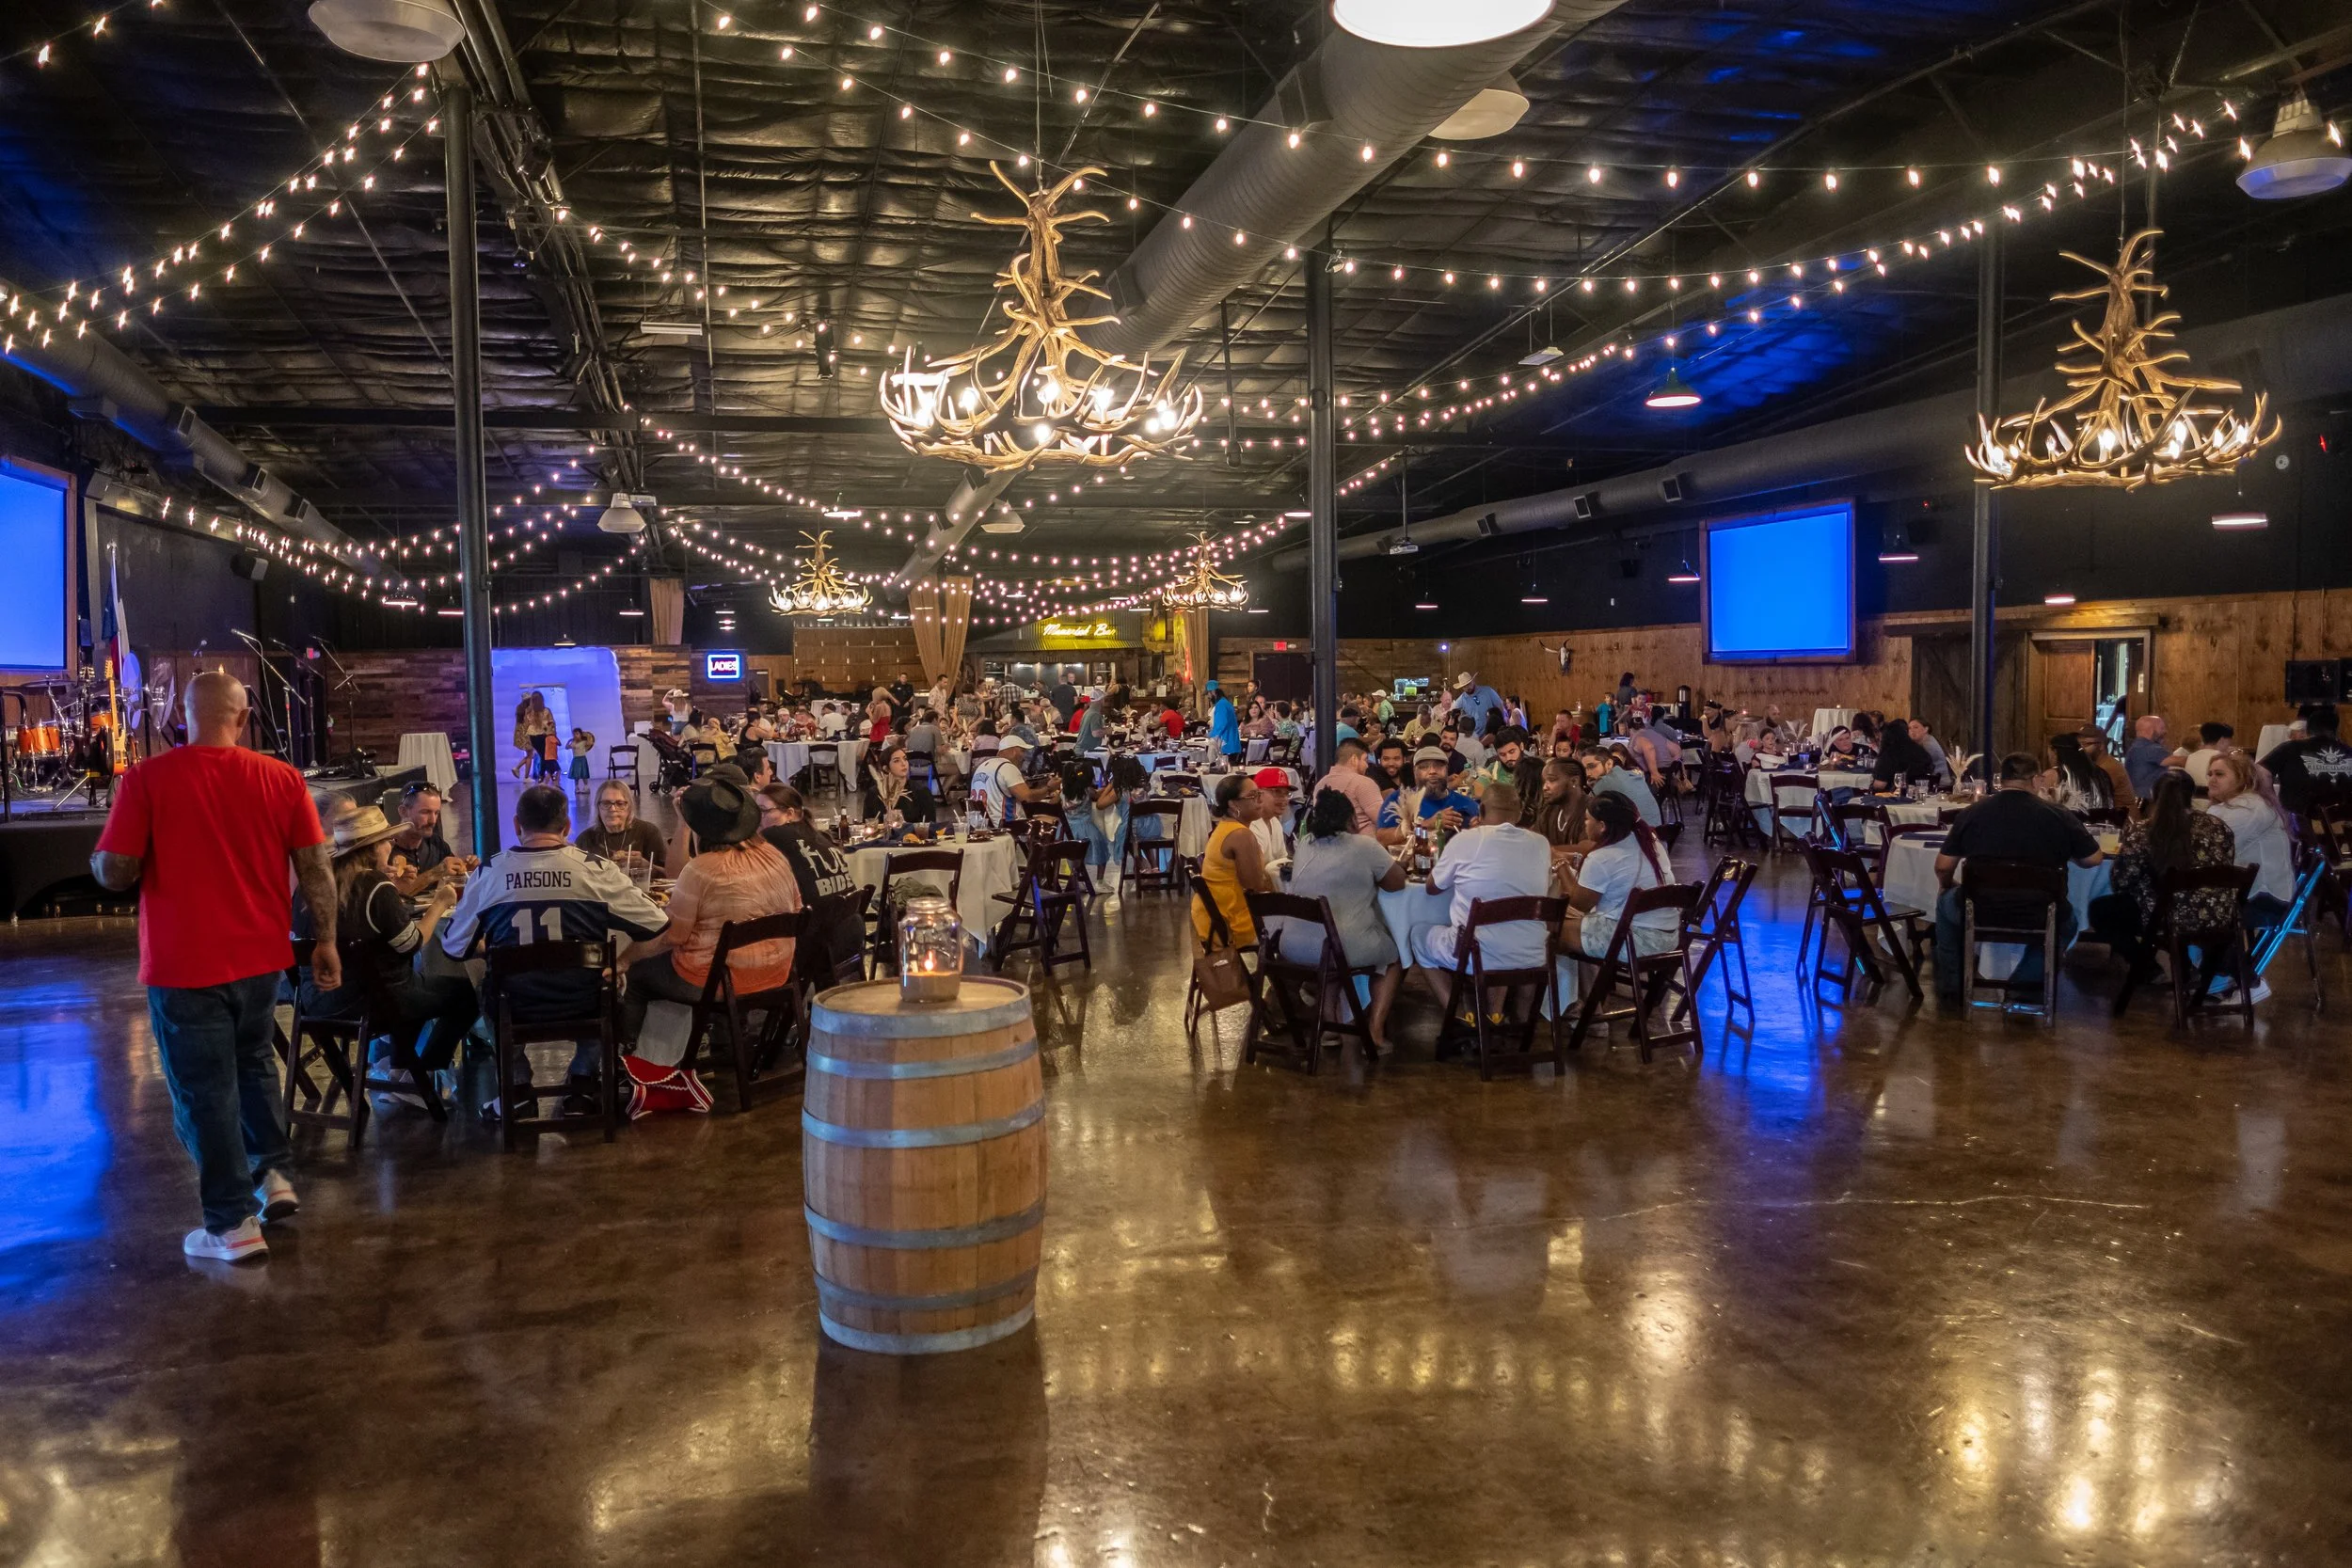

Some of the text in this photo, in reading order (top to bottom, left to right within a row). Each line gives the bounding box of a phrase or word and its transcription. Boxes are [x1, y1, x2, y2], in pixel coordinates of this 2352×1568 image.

[1094, 623, 1116, 636] Bar
[711, 660, 737, 672] LADIES
[506, 871, 571, 890] PARSONS
[815, 873, 854, 896] BIDE
[513, 908, 562, 945] 11
